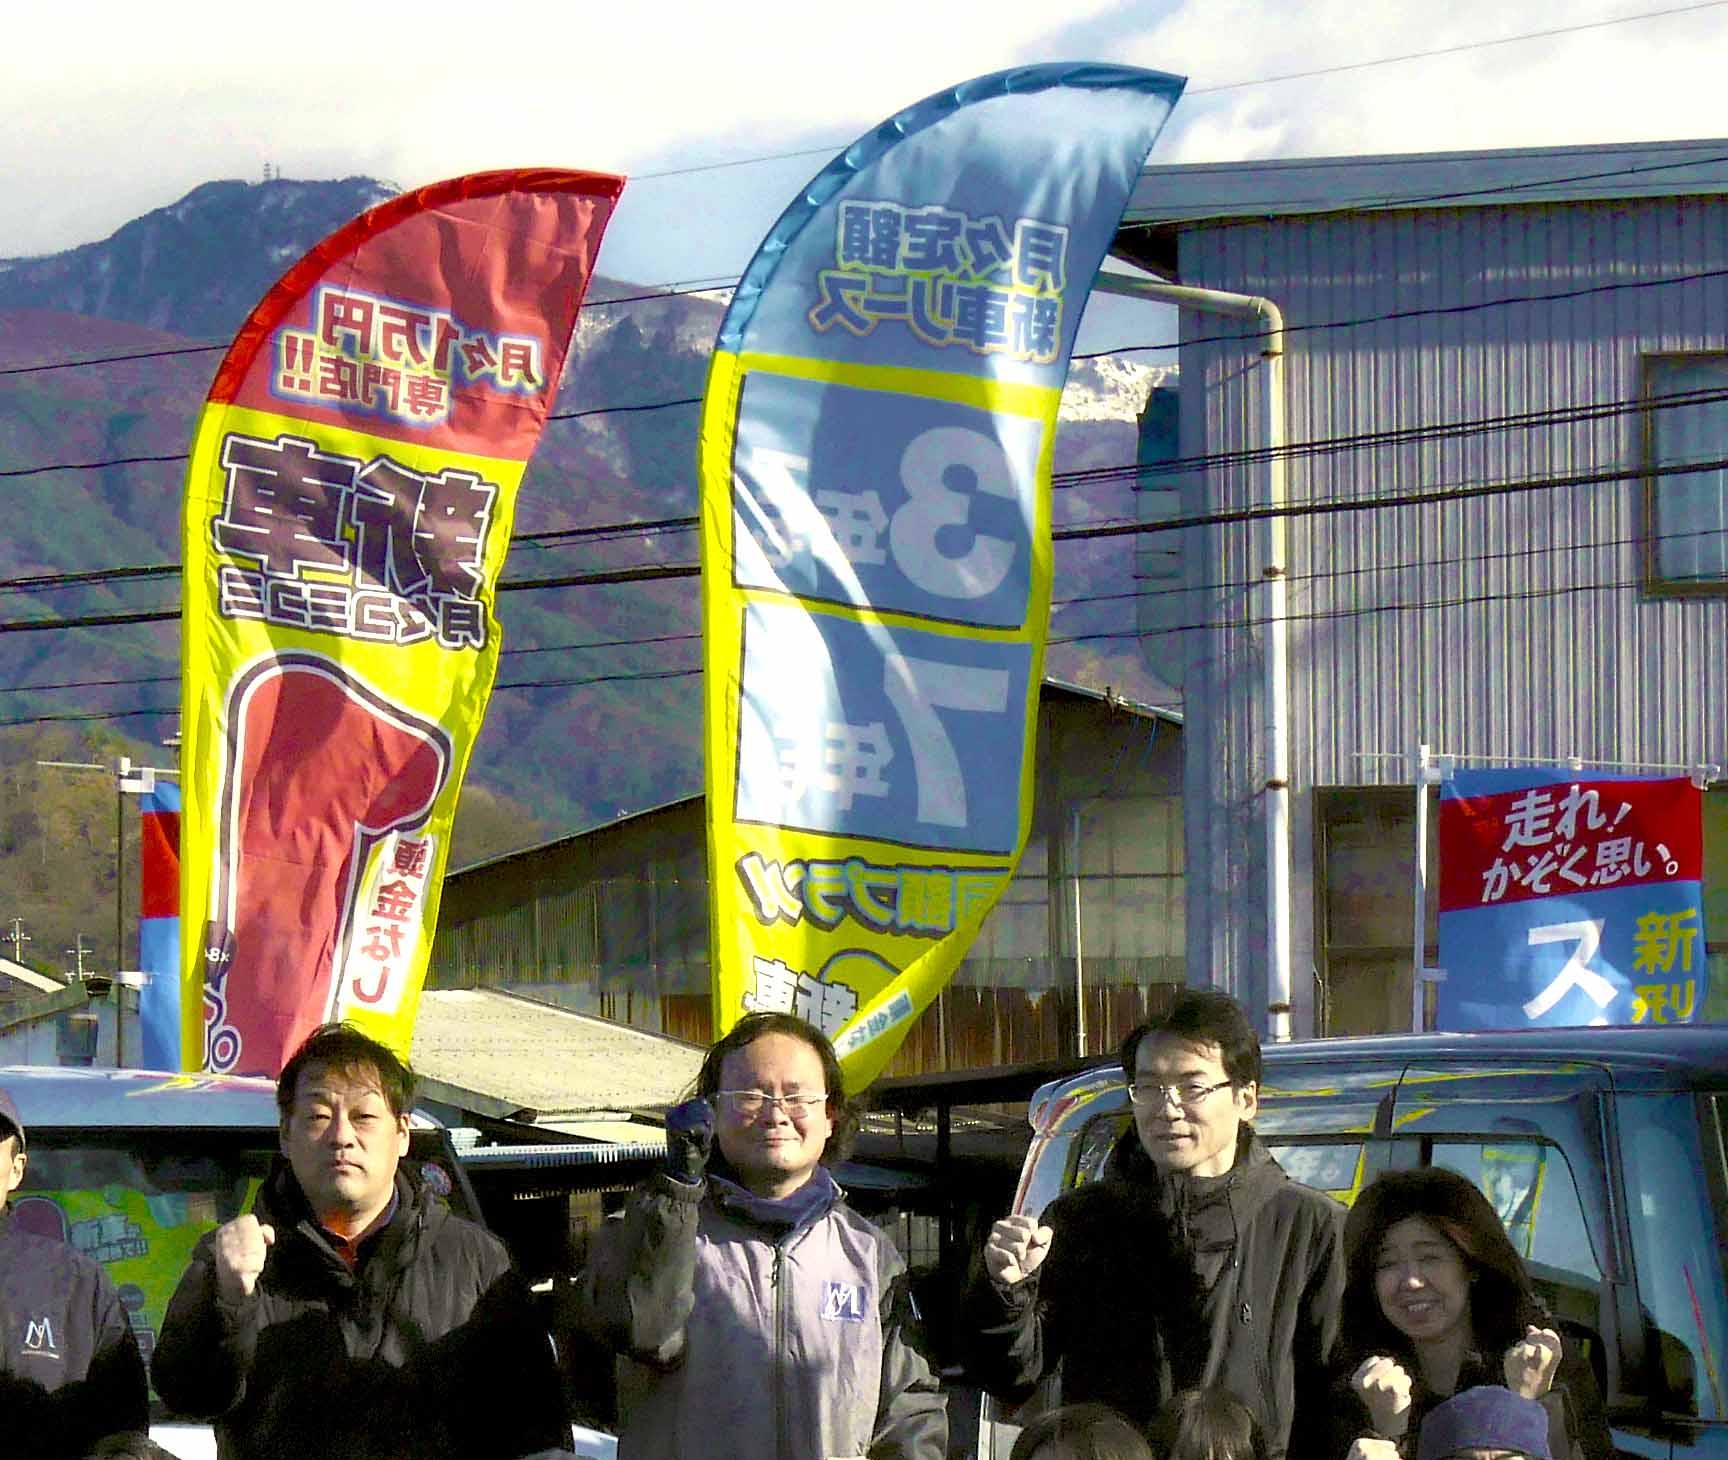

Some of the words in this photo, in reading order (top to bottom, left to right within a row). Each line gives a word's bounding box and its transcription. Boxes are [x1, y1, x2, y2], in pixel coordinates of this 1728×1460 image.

[1501, 786, 1634, 851] 走れ!
[1481, 836, 1680, 903] かぞく思い。
[1522, 918, 1619, 1019] ス
